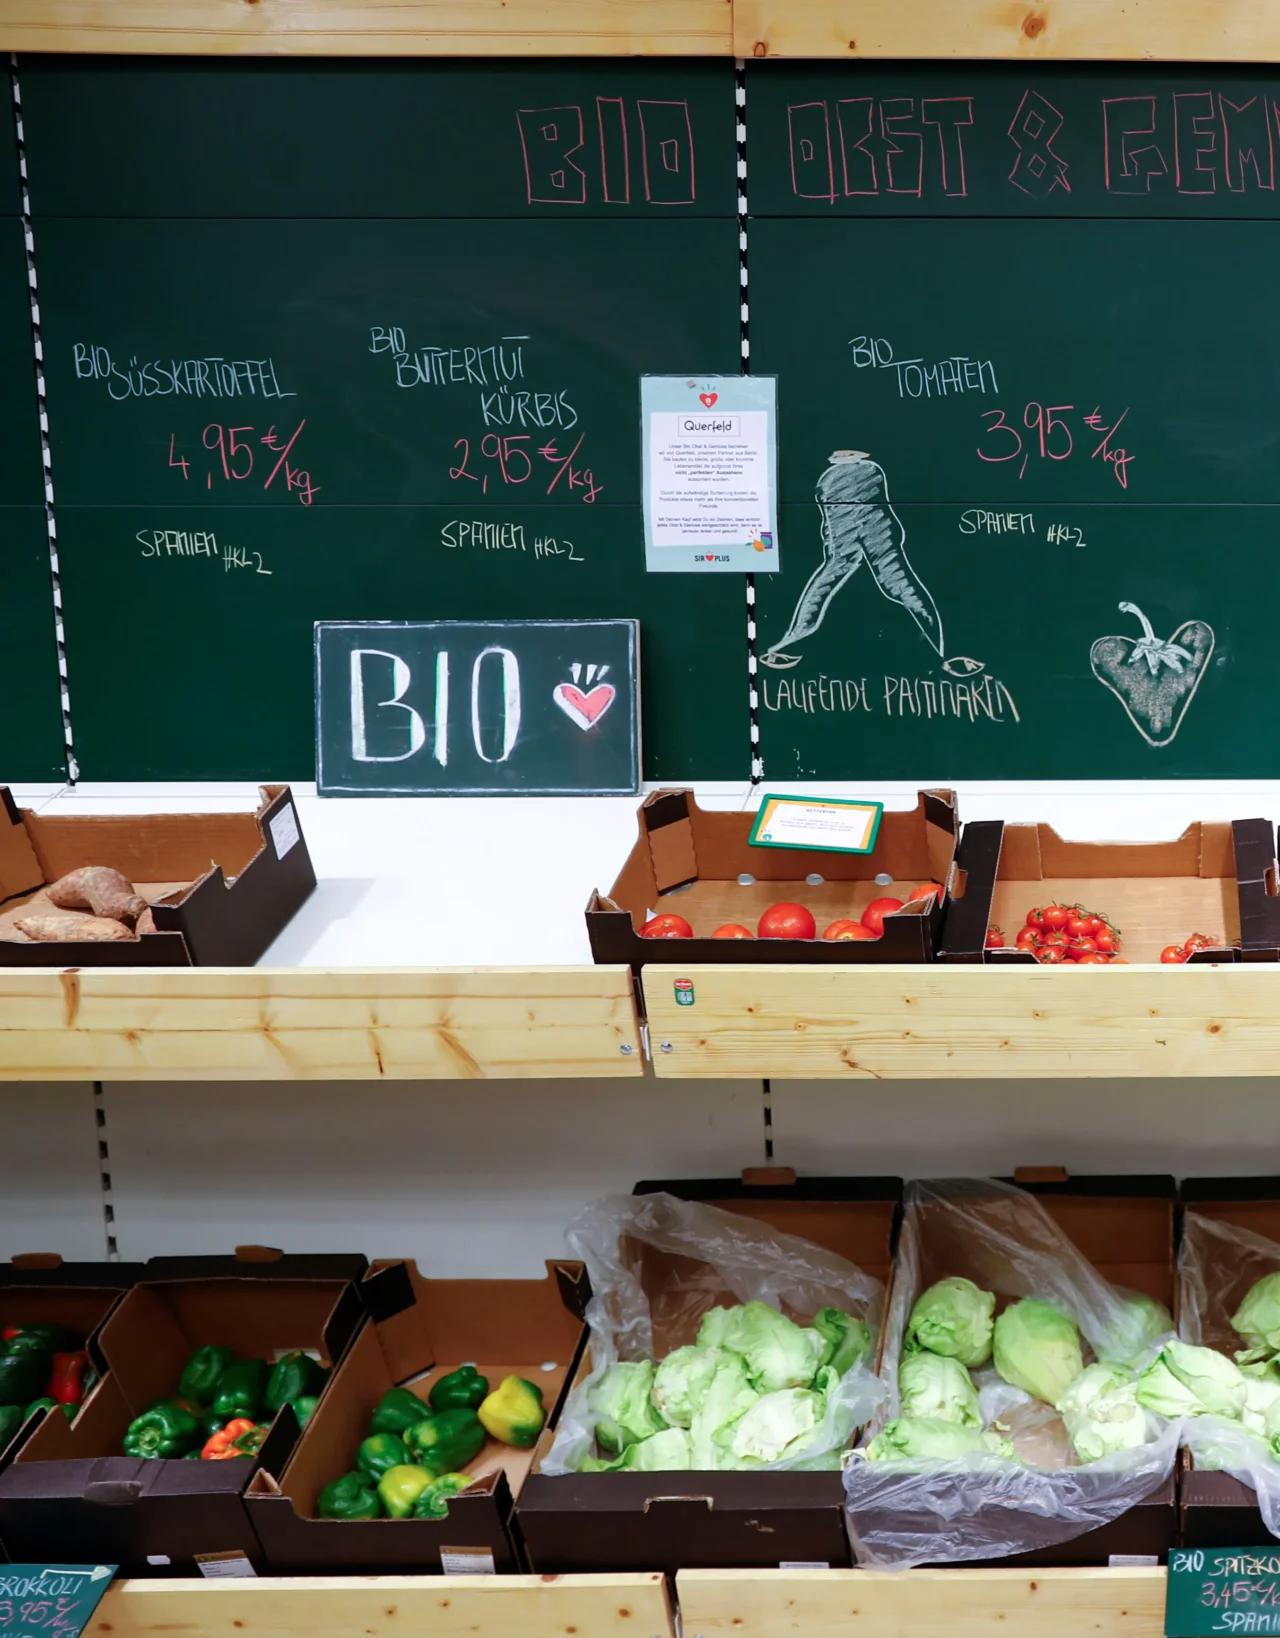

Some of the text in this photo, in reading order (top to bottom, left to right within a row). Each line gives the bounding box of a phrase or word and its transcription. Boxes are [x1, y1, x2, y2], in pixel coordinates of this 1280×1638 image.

[516, 96, 695, 204] BIO
[788, 97, 974, 204] OBST
[1007, 89, 1072, 199] &
[368, 326, 406, 354] BIO
[848, 336, 893, 368] BIO
[73, 343, 298, 400] BIO SÜSSKARTOFFEL
[879, 356, 999, 398] TOMATEN
[481, 384, 578, 430] KÜRBIS
[684, 420, 732, 433] Querfeld
[441, 520, 526, 551] SPANIEN
[958, 509, 1035, 534] SPANIEN
[135, 529, 218, 557] SPANIEN
[350, 645, 521, 767] BIO
[762, 672, 1020, 723] LAUFENDE PASTINAKEN
[1173, 1550, 1204, 1573] BIO
